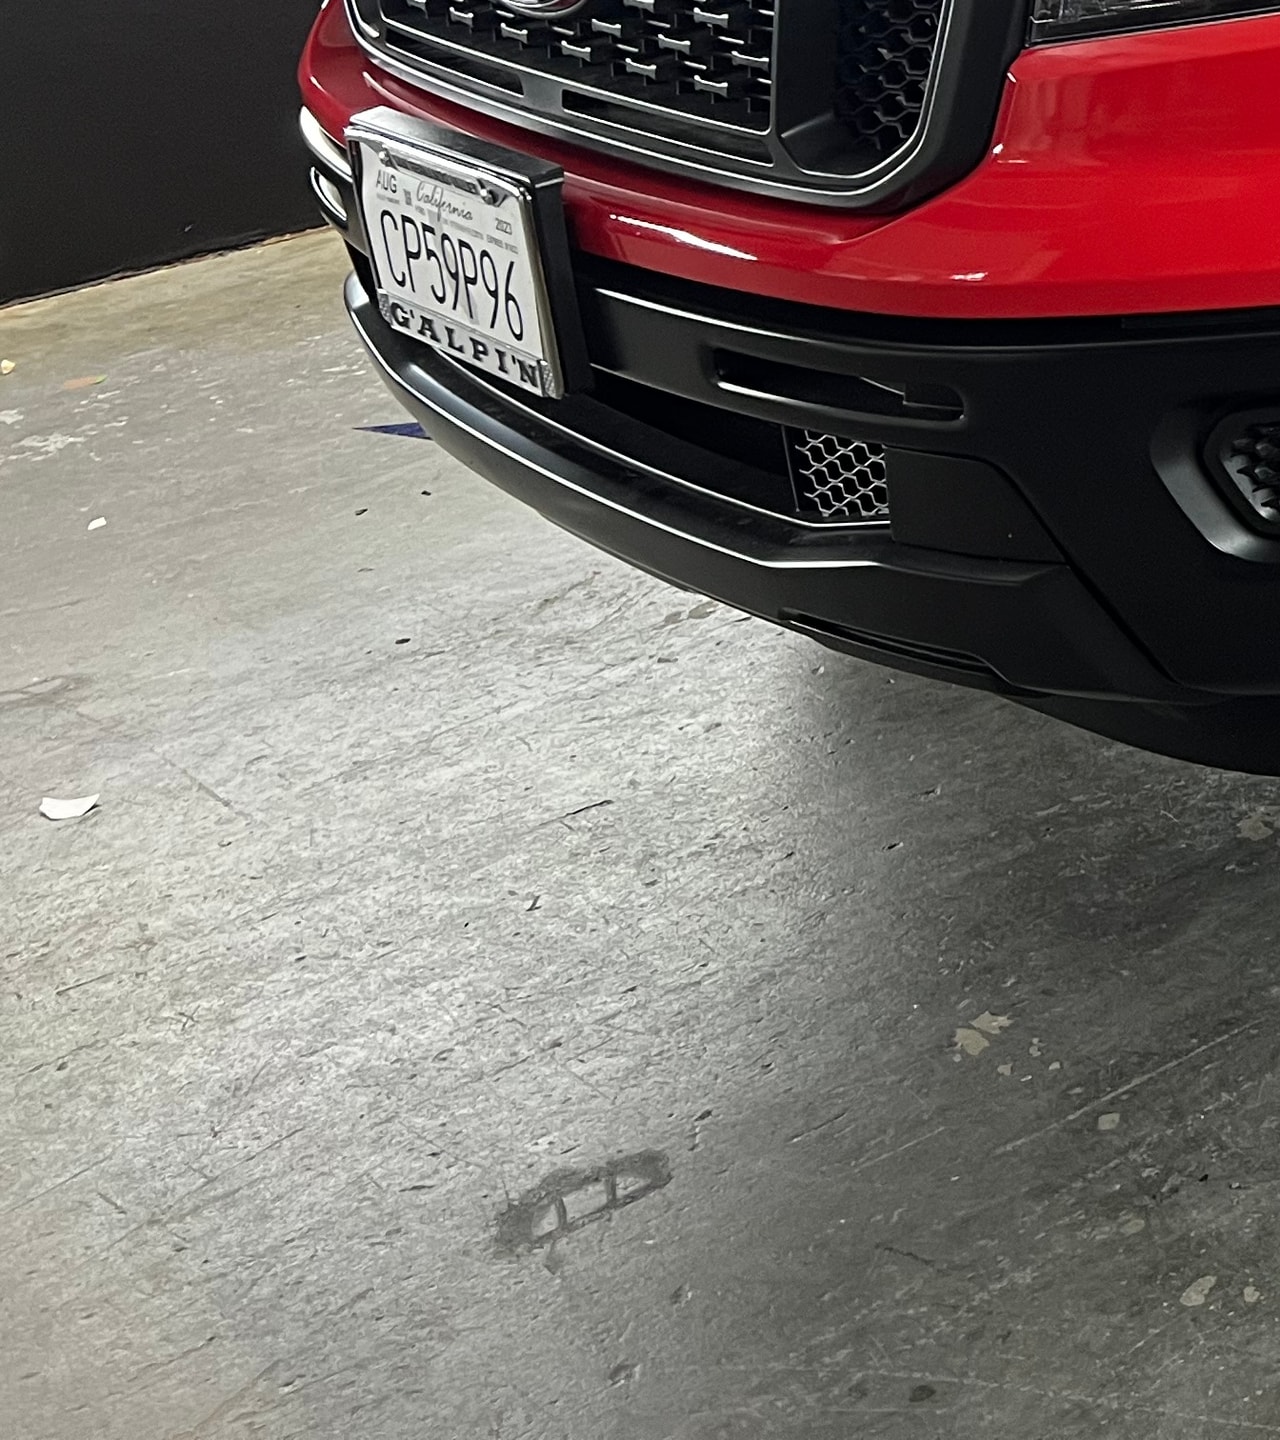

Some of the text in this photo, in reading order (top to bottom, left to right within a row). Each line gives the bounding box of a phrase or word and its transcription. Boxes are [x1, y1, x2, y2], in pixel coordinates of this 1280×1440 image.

[375, 169, 398, 195] AUG
[416, 180, 474, 222] California
[380, 209, 524, 342] CP59P96
[389, 301, 541, 390] GALPIN
